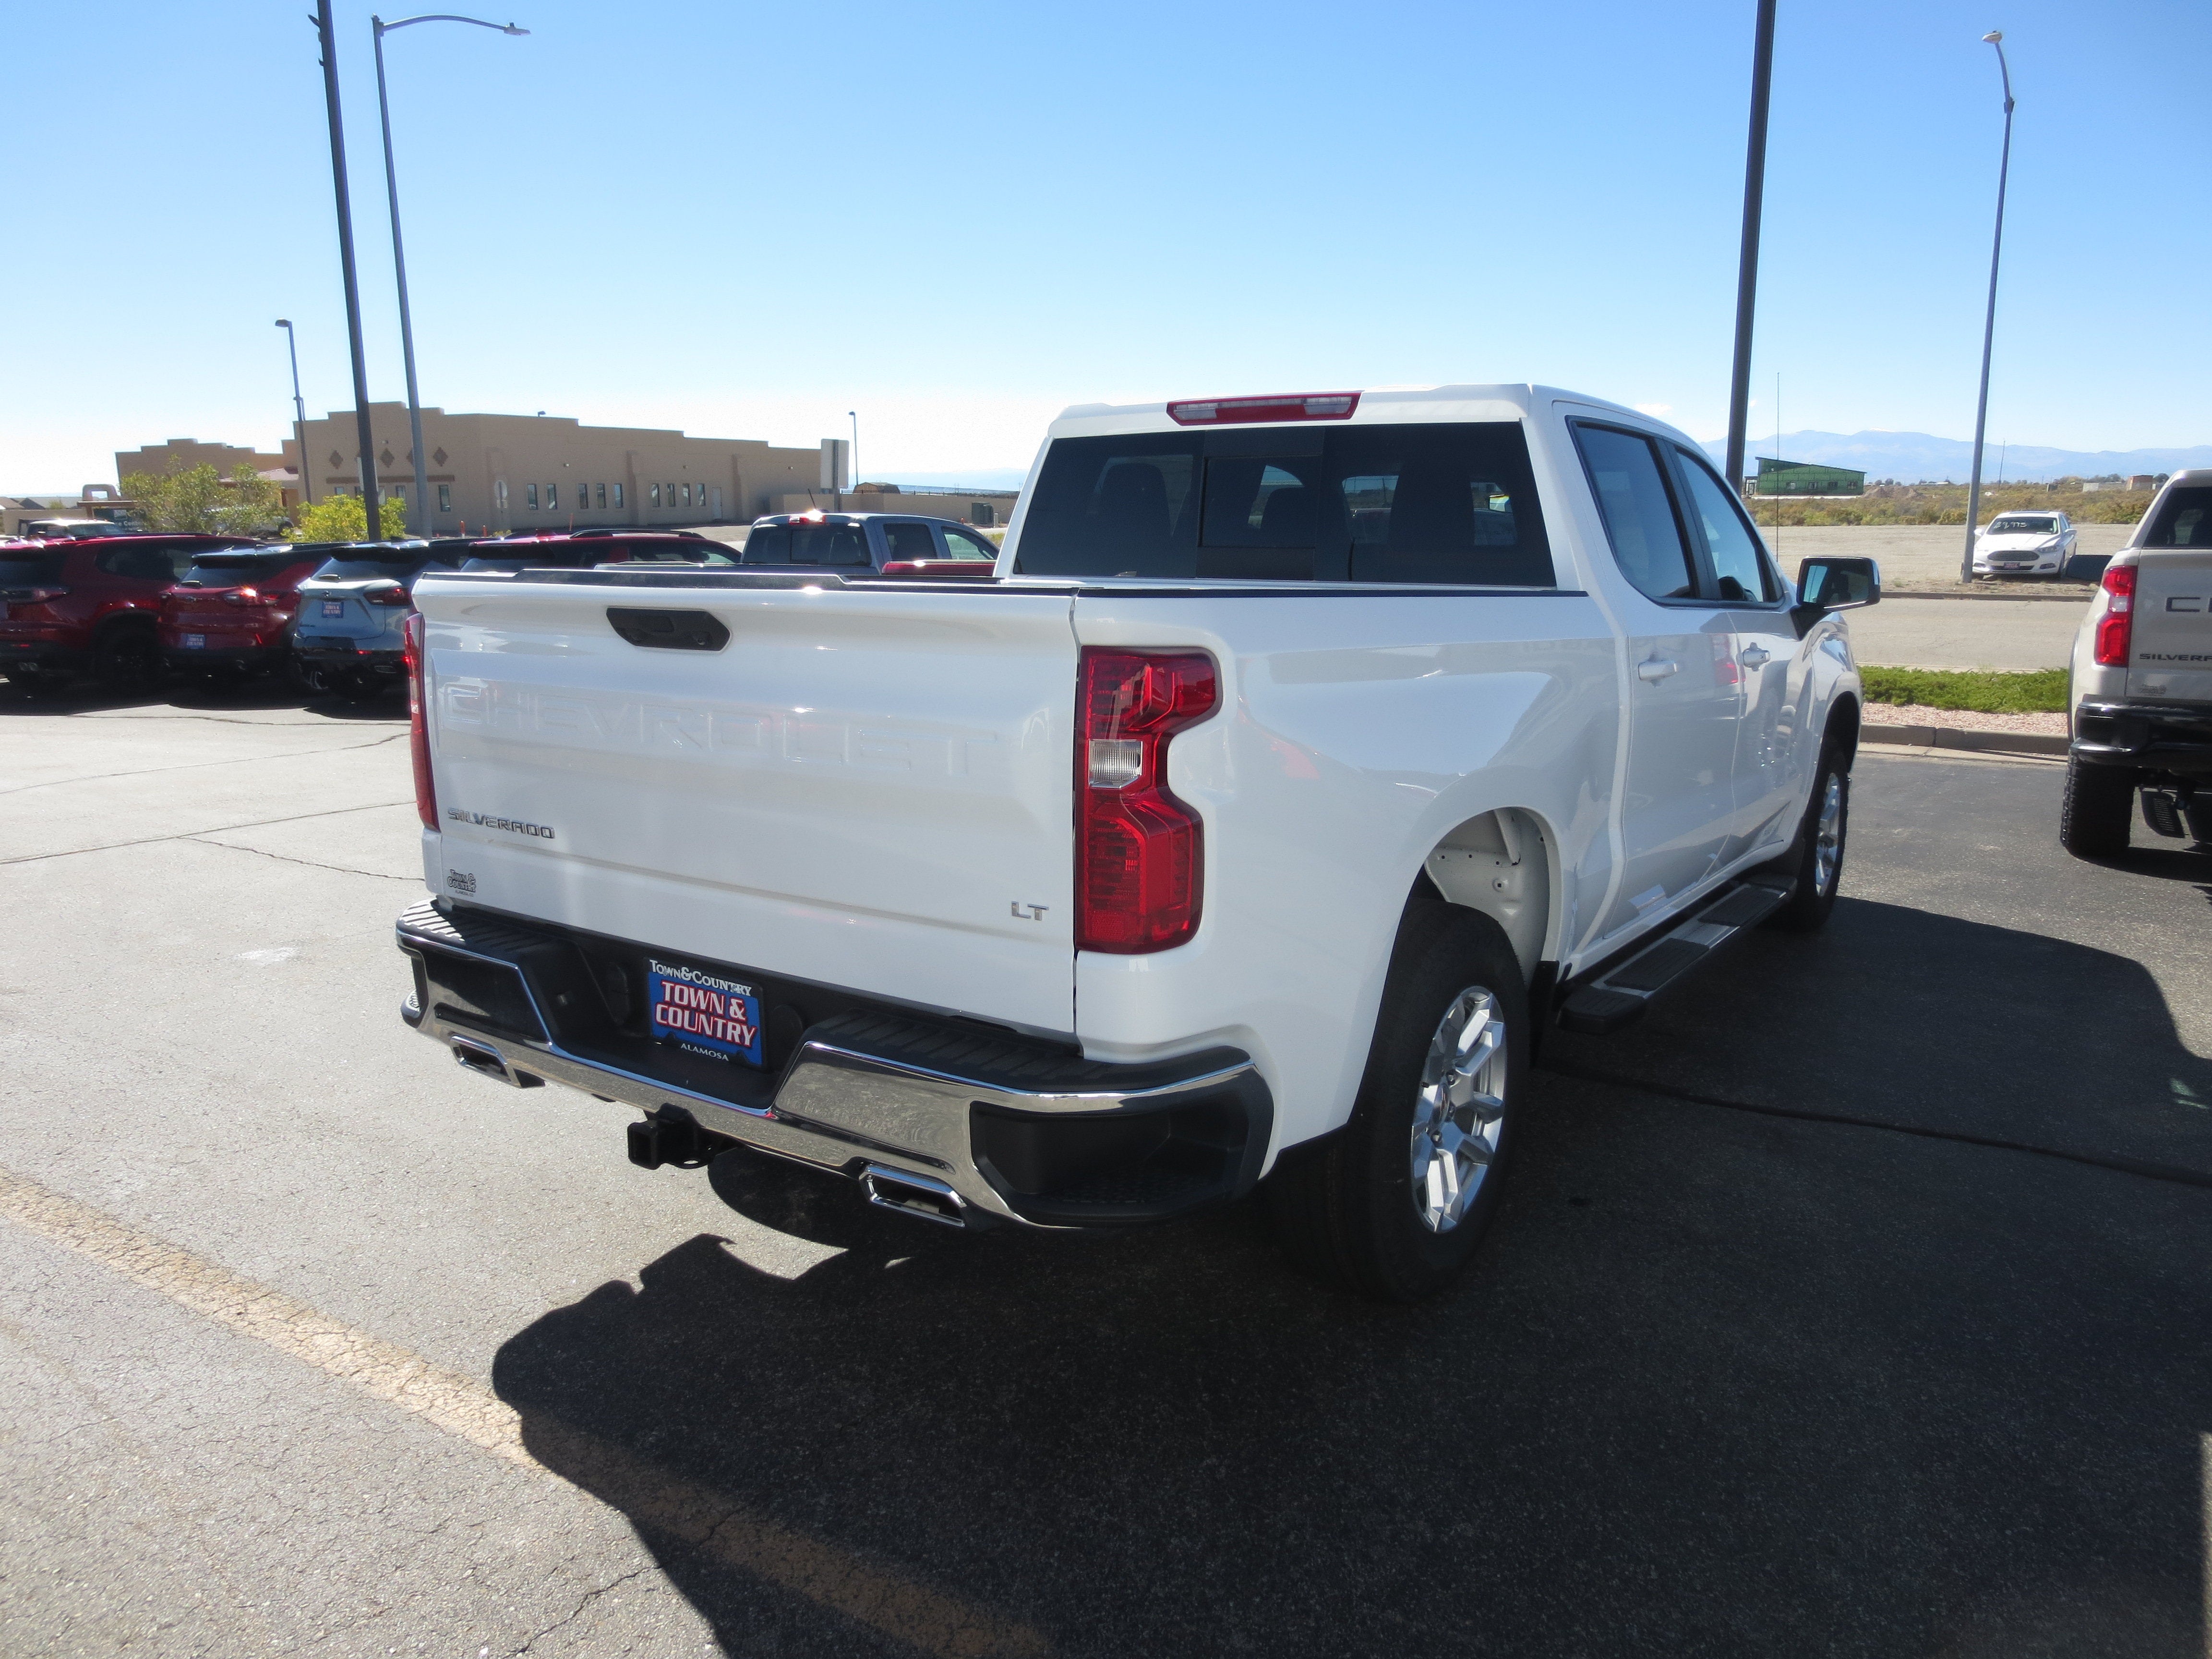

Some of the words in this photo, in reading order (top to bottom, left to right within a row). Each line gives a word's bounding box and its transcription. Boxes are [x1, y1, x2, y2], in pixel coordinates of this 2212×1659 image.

[2166, 597, 2212, 612] C
[442, 680, 998, 777] CHEVROLET
[447, 807, 555, 839] SILVERADO
[1011, 901, 1049, 921] LT
[660, 980, 726, 1016] TOWN
[728, 997, 747, 1022] &
[655, 1002, 757, 1048] COUNTRY
[680, 1043, 729, 1062] ALAMOSA
